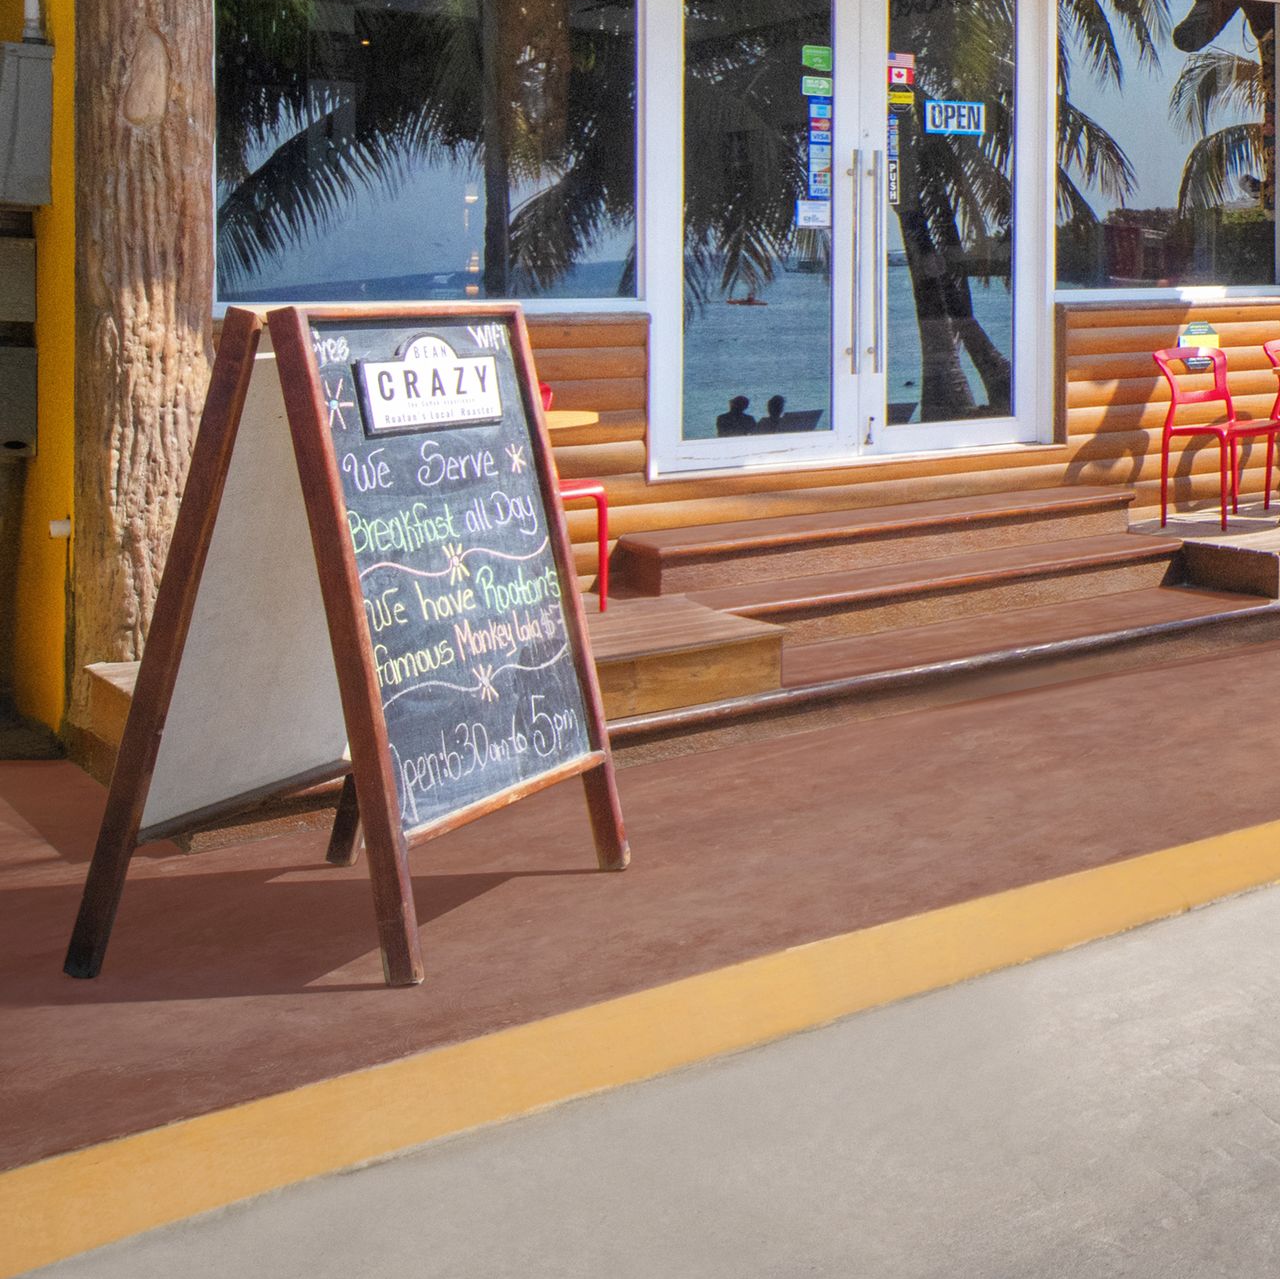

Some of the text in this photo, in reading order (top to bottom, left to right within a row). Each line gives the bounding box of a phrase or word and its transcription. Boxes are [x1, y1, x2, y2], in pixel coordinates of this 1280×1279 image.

[931, 104, 981, 130] OPEN
[889, 163, 898, 200] PUSH
[414, 345, 448, 360] BEAN
[378, 365, 488, 401] CRAZY
[343, 440, 499, 492] We Serve
[347, 491, 538, 554] Breakfast all Day
[364, 588, 408, 632] We
[414, 581, 476, 621] have
[374, 640, 455, 687] famous
[454, 619, 517, 662] Monkey
[530, 694, 580, 758] 5pm
